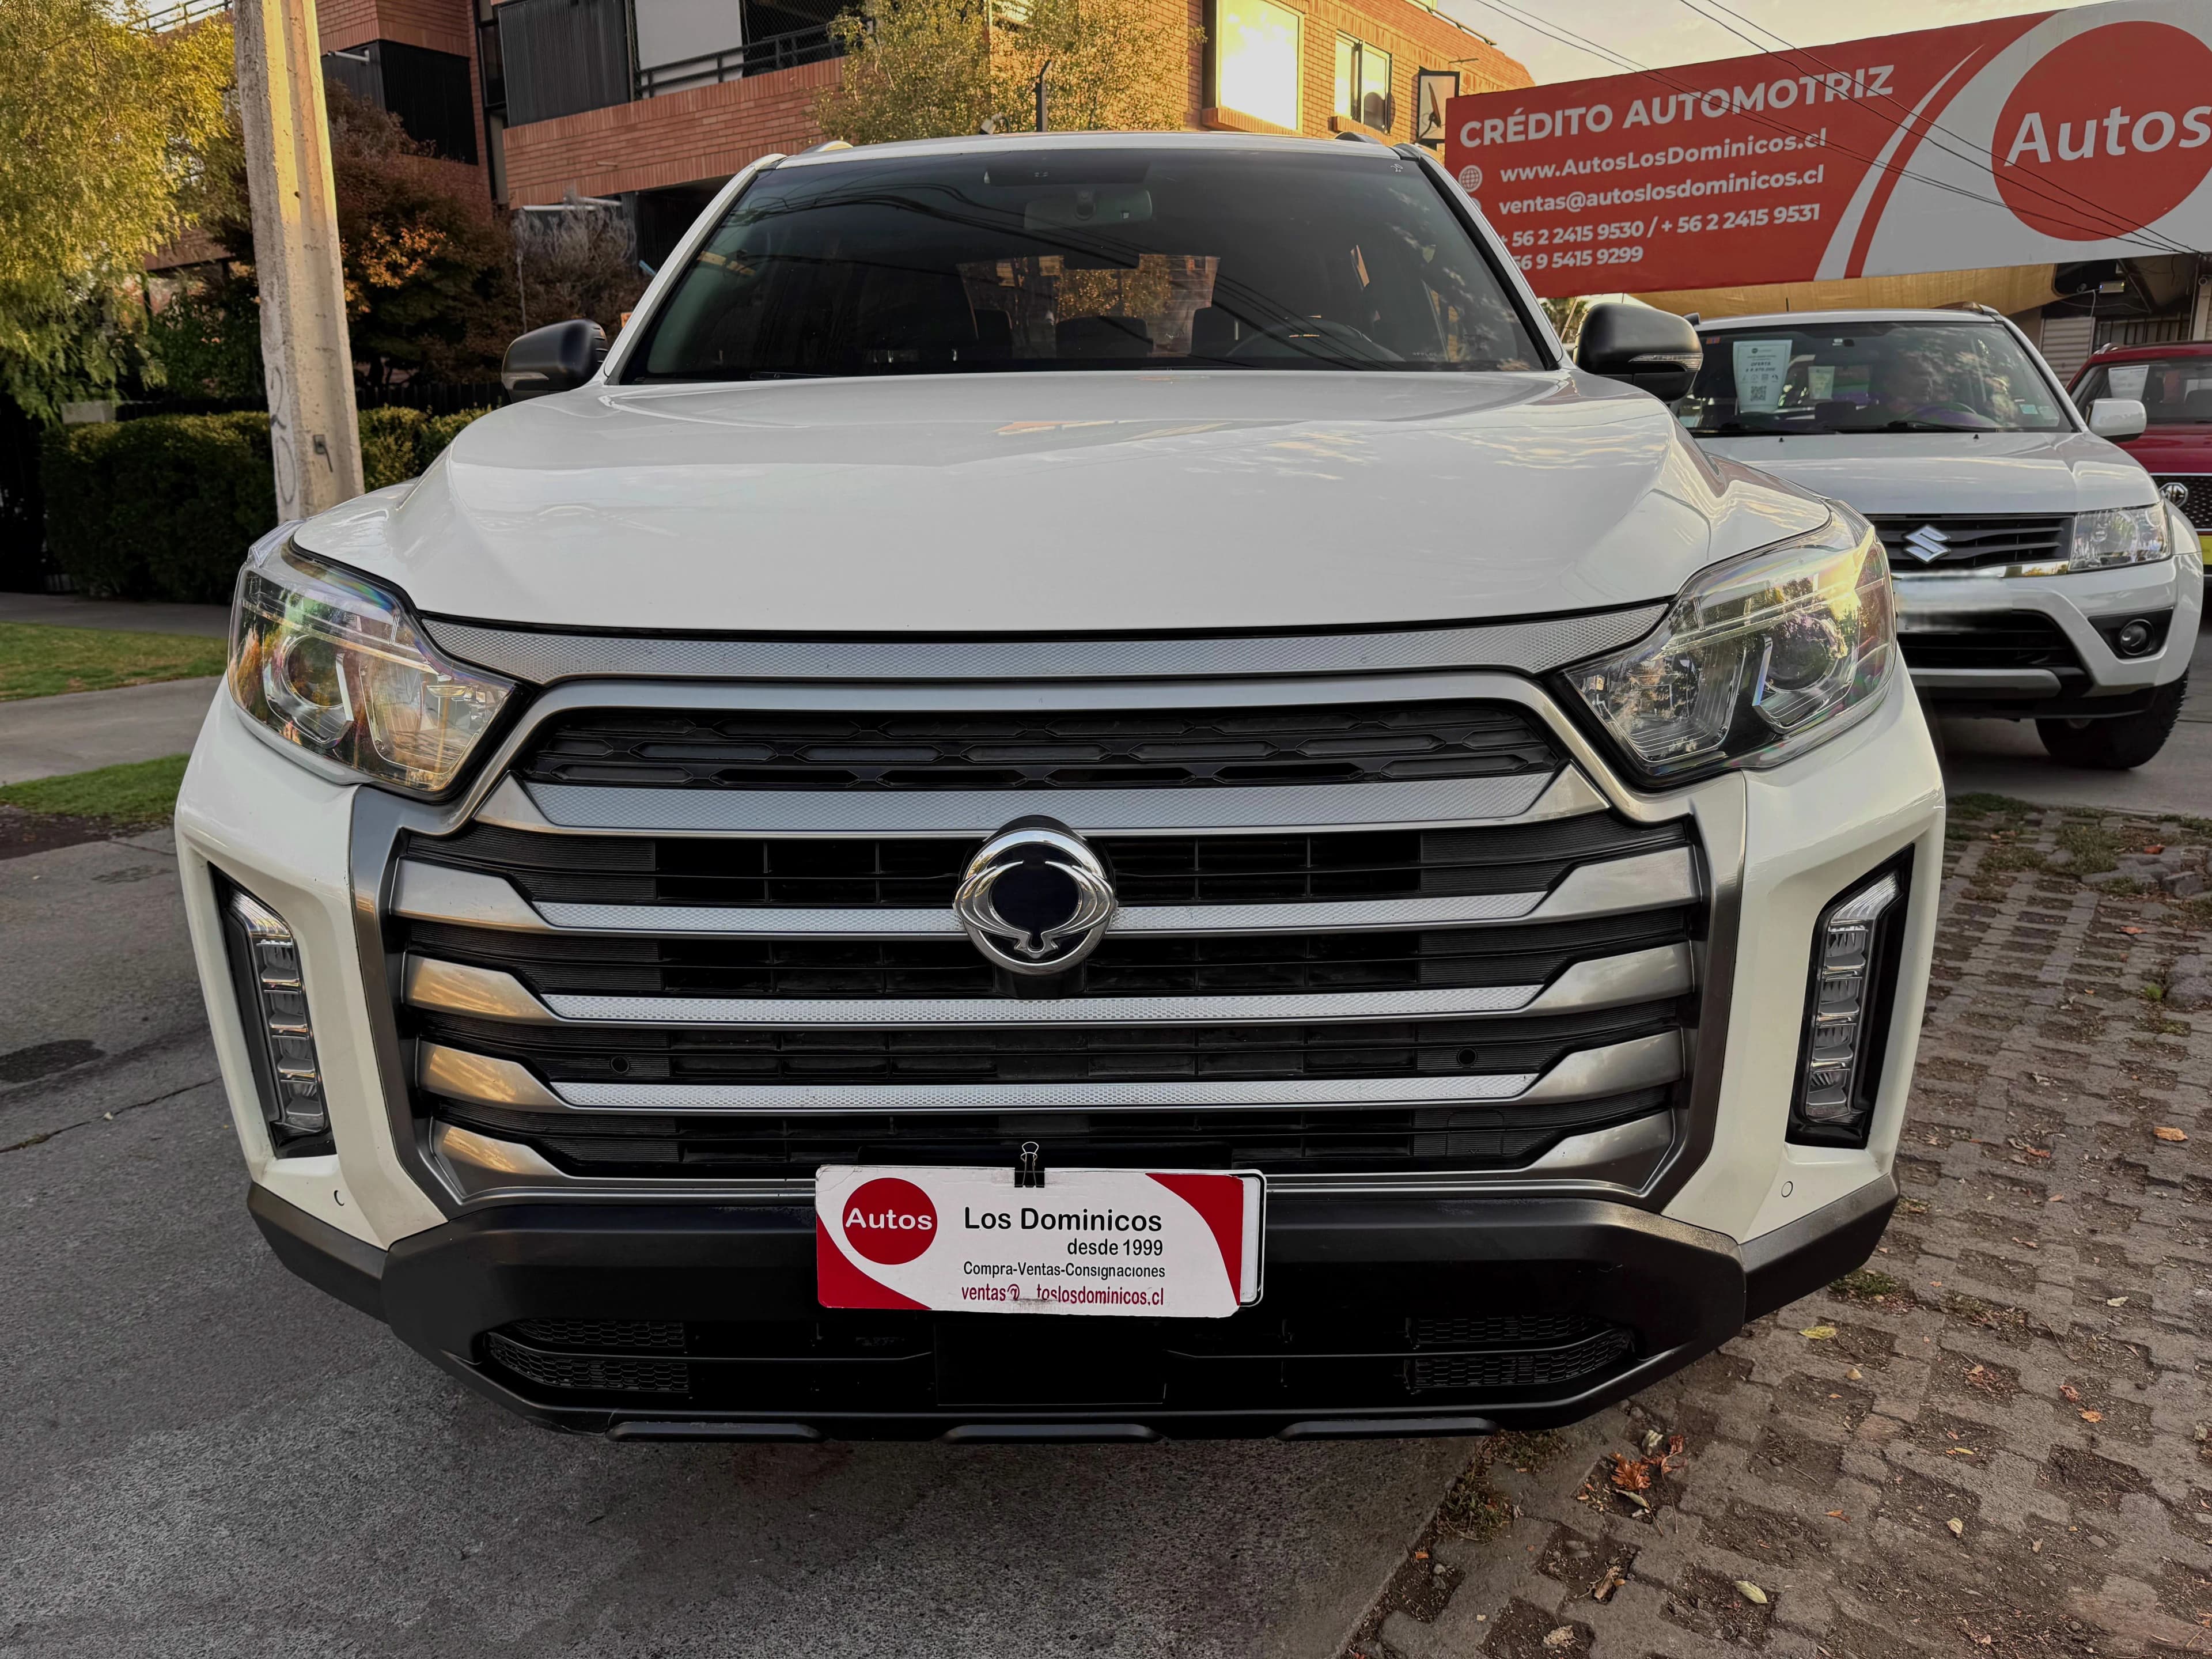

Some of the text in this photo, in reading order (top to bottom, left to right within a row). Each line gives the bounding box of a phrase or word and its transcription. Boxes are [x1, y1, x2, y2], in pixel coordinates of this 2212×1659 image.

[1460, 65, 1895, 148] CRÉDITO AUTOMOTRIZ
[2003, 106, 2212, 166] Autos
[1500, 128, 1826, 182] www.AutosLosDominicos.cl
[1499, 164, 1824, 215] ventas@autoslosdominicos.cl
[1512, 230, 1535, 247] 56
[1537, 229, 1549, 245] 2
[1552, 225, 1593, 244] 2415
[1597, 221, 1644, 241] 9530
[1677, 215, 1702, 233] 56
[1706, 213, 1719, 230] 2
[1722, 208, 1769, 229] 2415
[1773, 203, 1820, 225] 9531
[1536, 253, 1548, 270] 9
[1551, 251, 1593, 268] 5415
[1596, 246, 1644, 265] 9299
[845, 1207, 933, 1230] Autos
[965, 1207, 1162, 1232] Los Dominicos
[1067, 1238, 1164, 1256] desde 1999
[963, 1261, 1166, 1280] Compra-Ventas-Consignaciones
